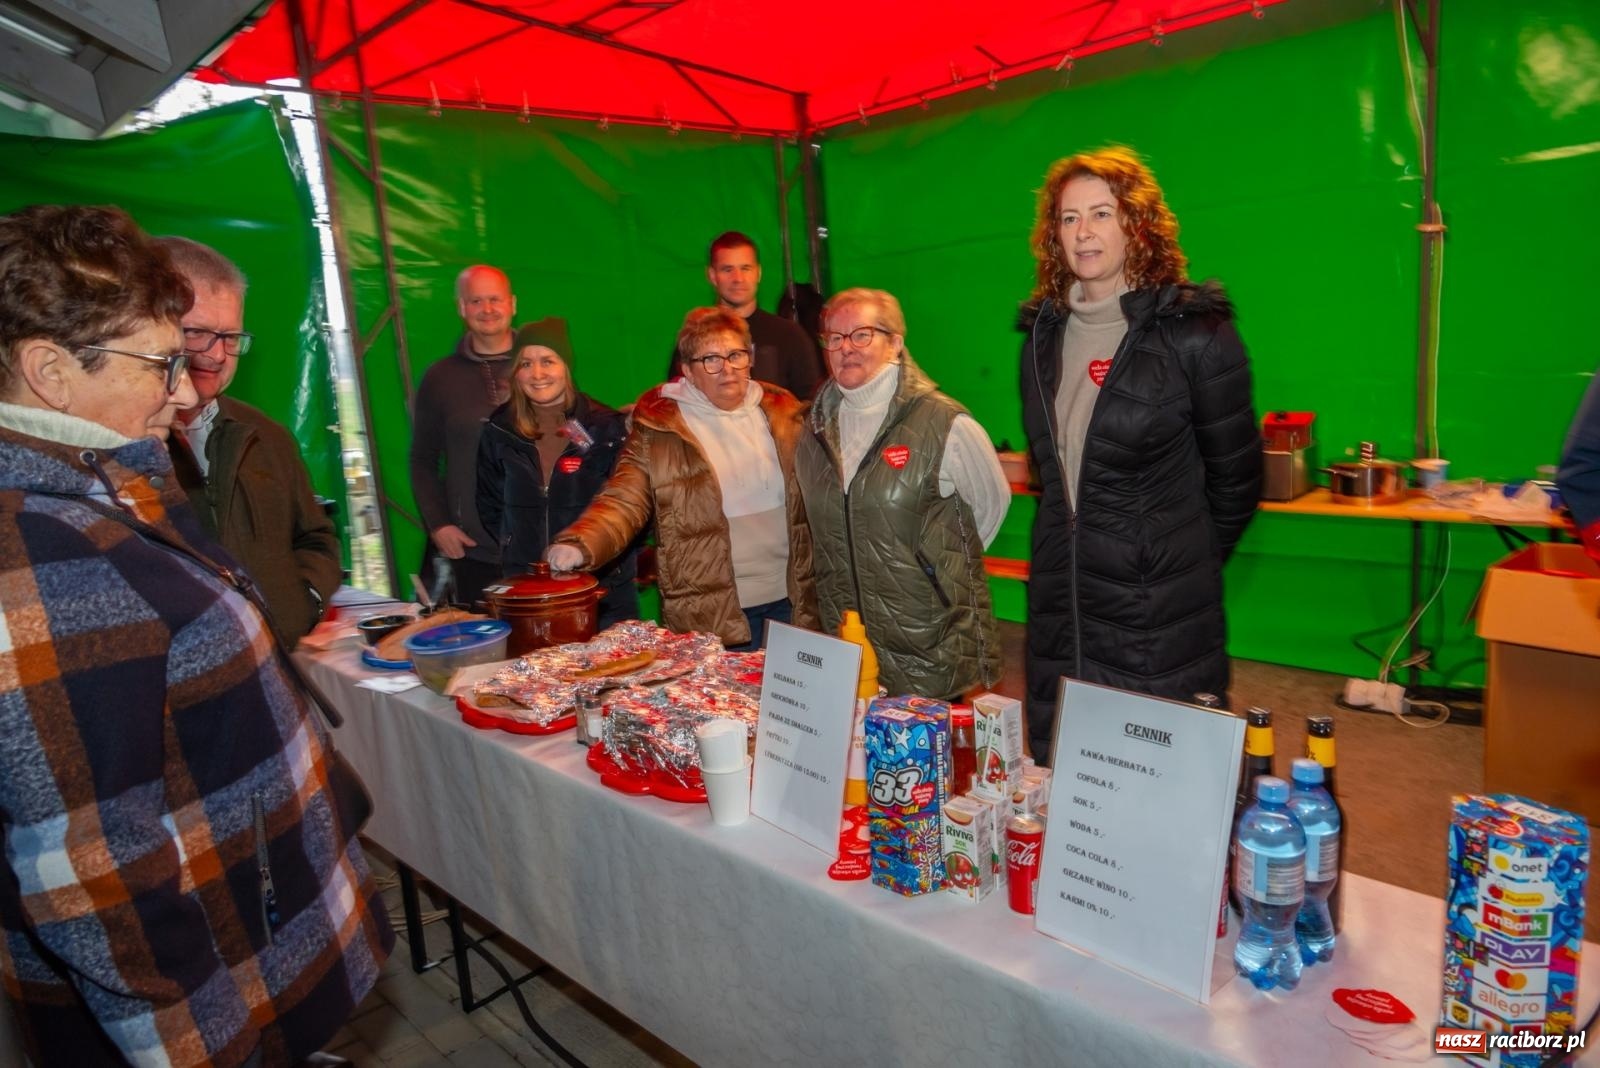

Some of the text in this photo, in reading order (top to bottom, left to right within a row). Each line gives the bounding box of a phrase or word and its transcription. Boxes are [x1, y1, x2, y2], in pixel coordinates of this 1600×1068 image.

[797, 650, 823, 667] CENNIK
[1124, 722, 1173, 745] CENNIK
[872, 767, 922, 806] 33
[1076, 772, 1106, 788] COFOLA
[1072, 795, 1088, 807] SOK
[945, 824, 974, 842] Riviva
[1069, 819, 1091, 834] WODA
[1065, 843, 1086, 857] COCA
[1088, 851, 1109, 866] COLA
[1511, 863, 1543, 873] onet
[1096, 879, 1116, 894] WINO
[1059, 891, 1085, 908] KARMI
[1487, 911, 1543, 932] mBank
[1484, 937, 1540, 960] PLAY
[1478, 990, 1540, 1018] allegro
